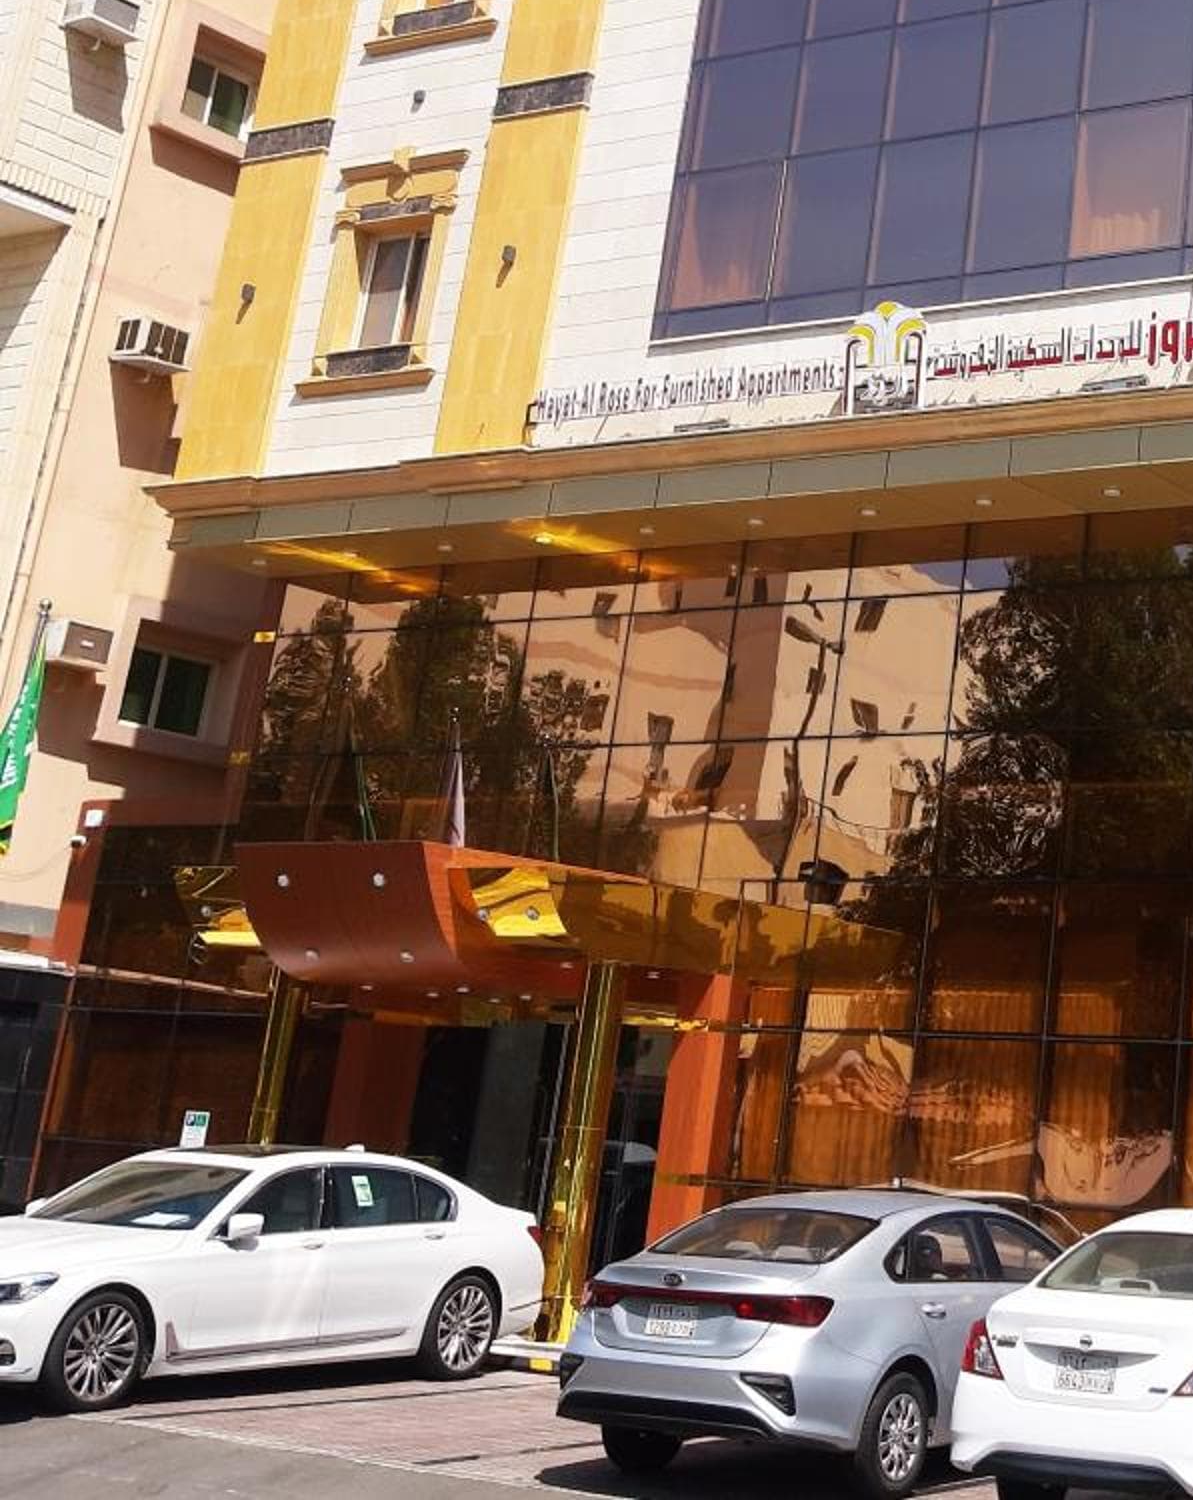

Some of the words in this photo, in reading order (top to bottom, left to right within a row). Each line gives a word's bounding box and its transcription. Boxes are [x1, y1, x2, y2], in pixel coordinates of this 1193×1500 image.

[1006, 326, 1073, 373] السكنية
[1072, 318, 1144, 363] للوحدات
[536, 389, 577, 426] Hayat
[580, 382, 596, 414] Al
[600, 381, 631, 412] Rose
[634, 377, 658, 409] For
[661, 367, 734, 406] Furnished
